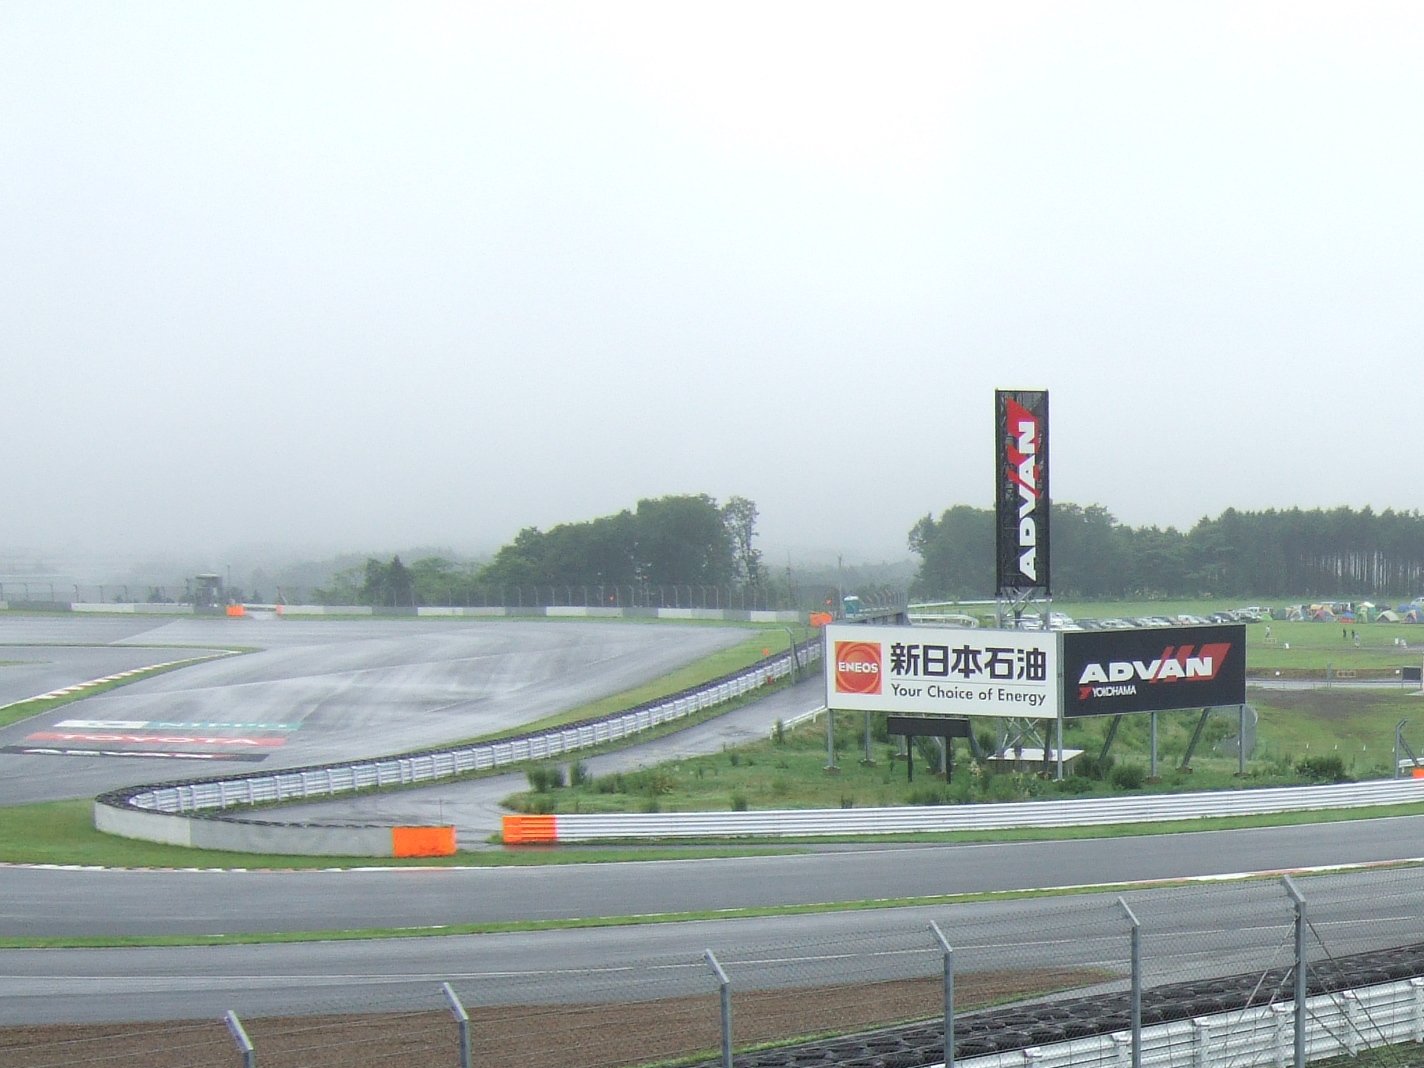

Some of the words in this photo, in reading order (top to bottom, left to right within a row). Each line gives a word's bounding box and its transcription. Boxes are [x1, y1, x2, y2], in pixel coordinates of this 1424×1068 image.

[1018, 420, 1037, 582] ADVAN
[838, 661, 879, 674] ENEOS
[890, 642, 1047, 681] 新日本石油
[1079, 656, 1213, 685] ADVAN
[891, 683, 923, 698] Your
[927, 684, 973, 700] Choice
[978, 687, 993, 701] of
[997, 688, 1047, 706] Energy
[1092, 685, 1137, 698] YOKOHAMA
[57, 734, 259, 745] TOYOTA
